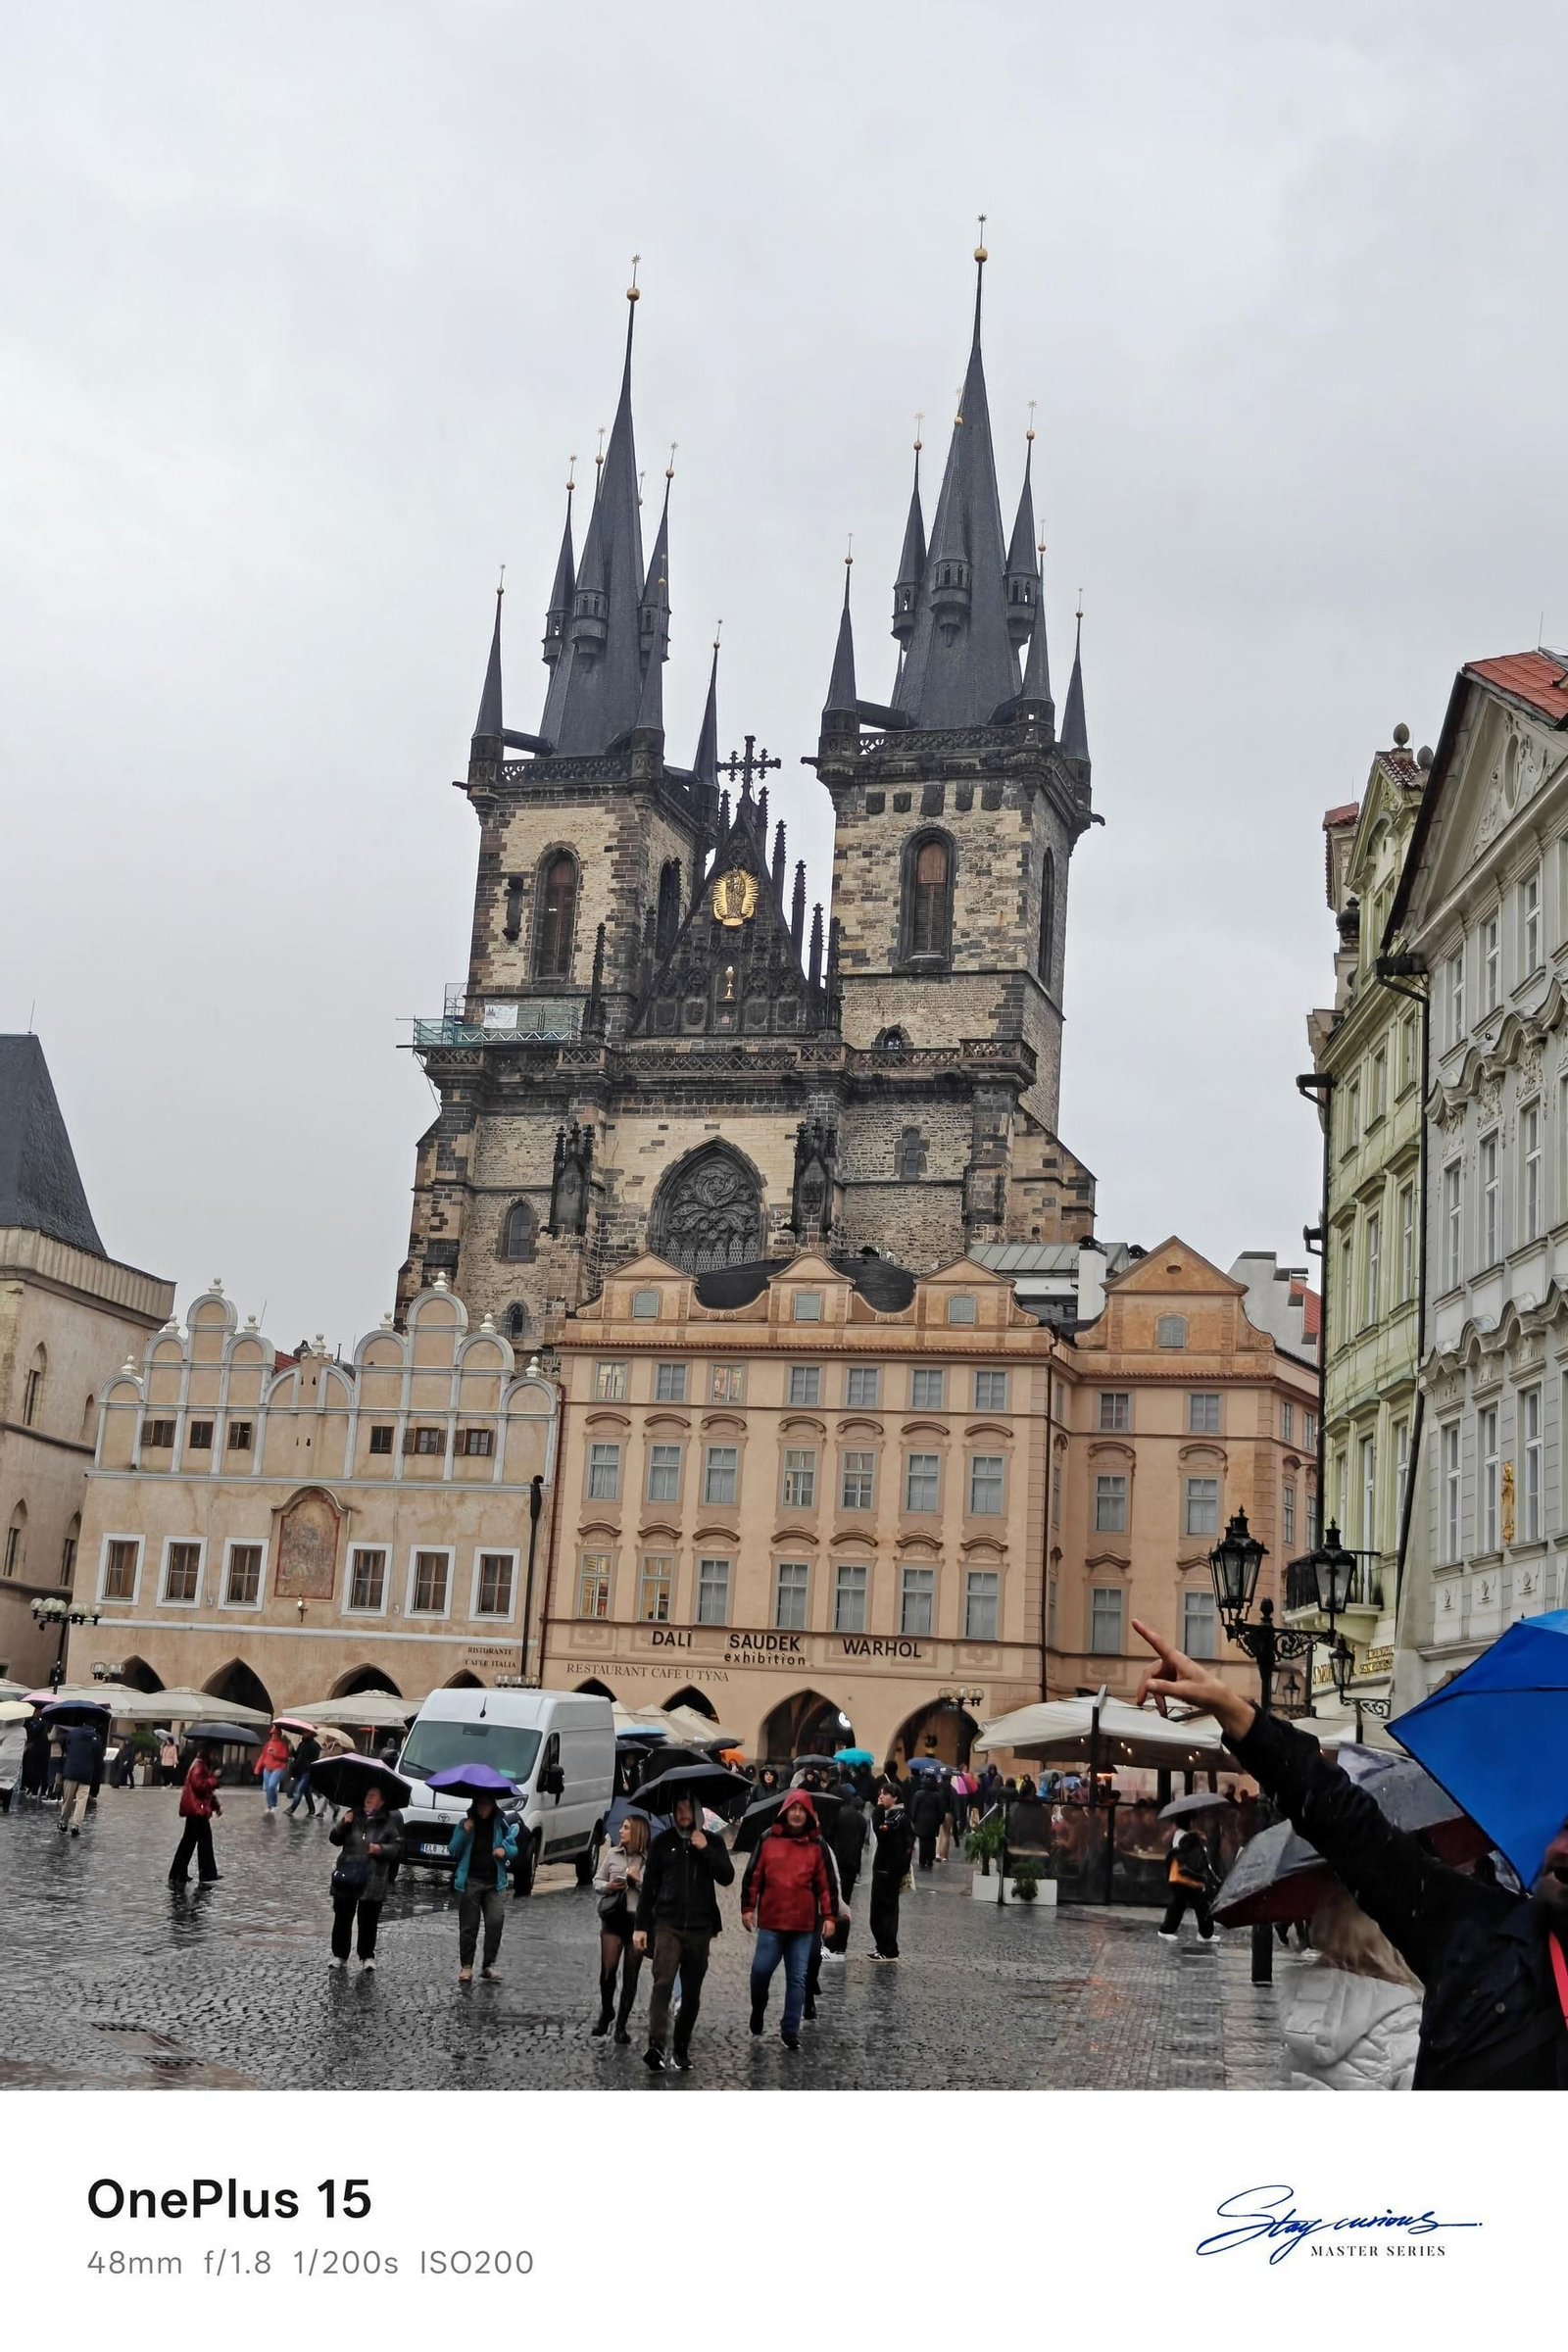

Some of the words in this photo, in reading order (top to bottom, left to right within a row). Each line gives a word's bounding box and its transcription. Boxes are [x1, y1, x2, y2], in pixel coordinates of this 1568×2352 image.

[729, 1634, 801, 1652] SAUDEK
[842, 1638, 922, 1658] WARHOL
[724, 1651, 806, 1666] exhibition
[566, 1663, 648, 1678] RESTAURANT
[651, 1666, 681, 1680] CAFÉ
[685, 1669, 694, 1680] U
[697, 1668, 729, 1683] TÝNA
